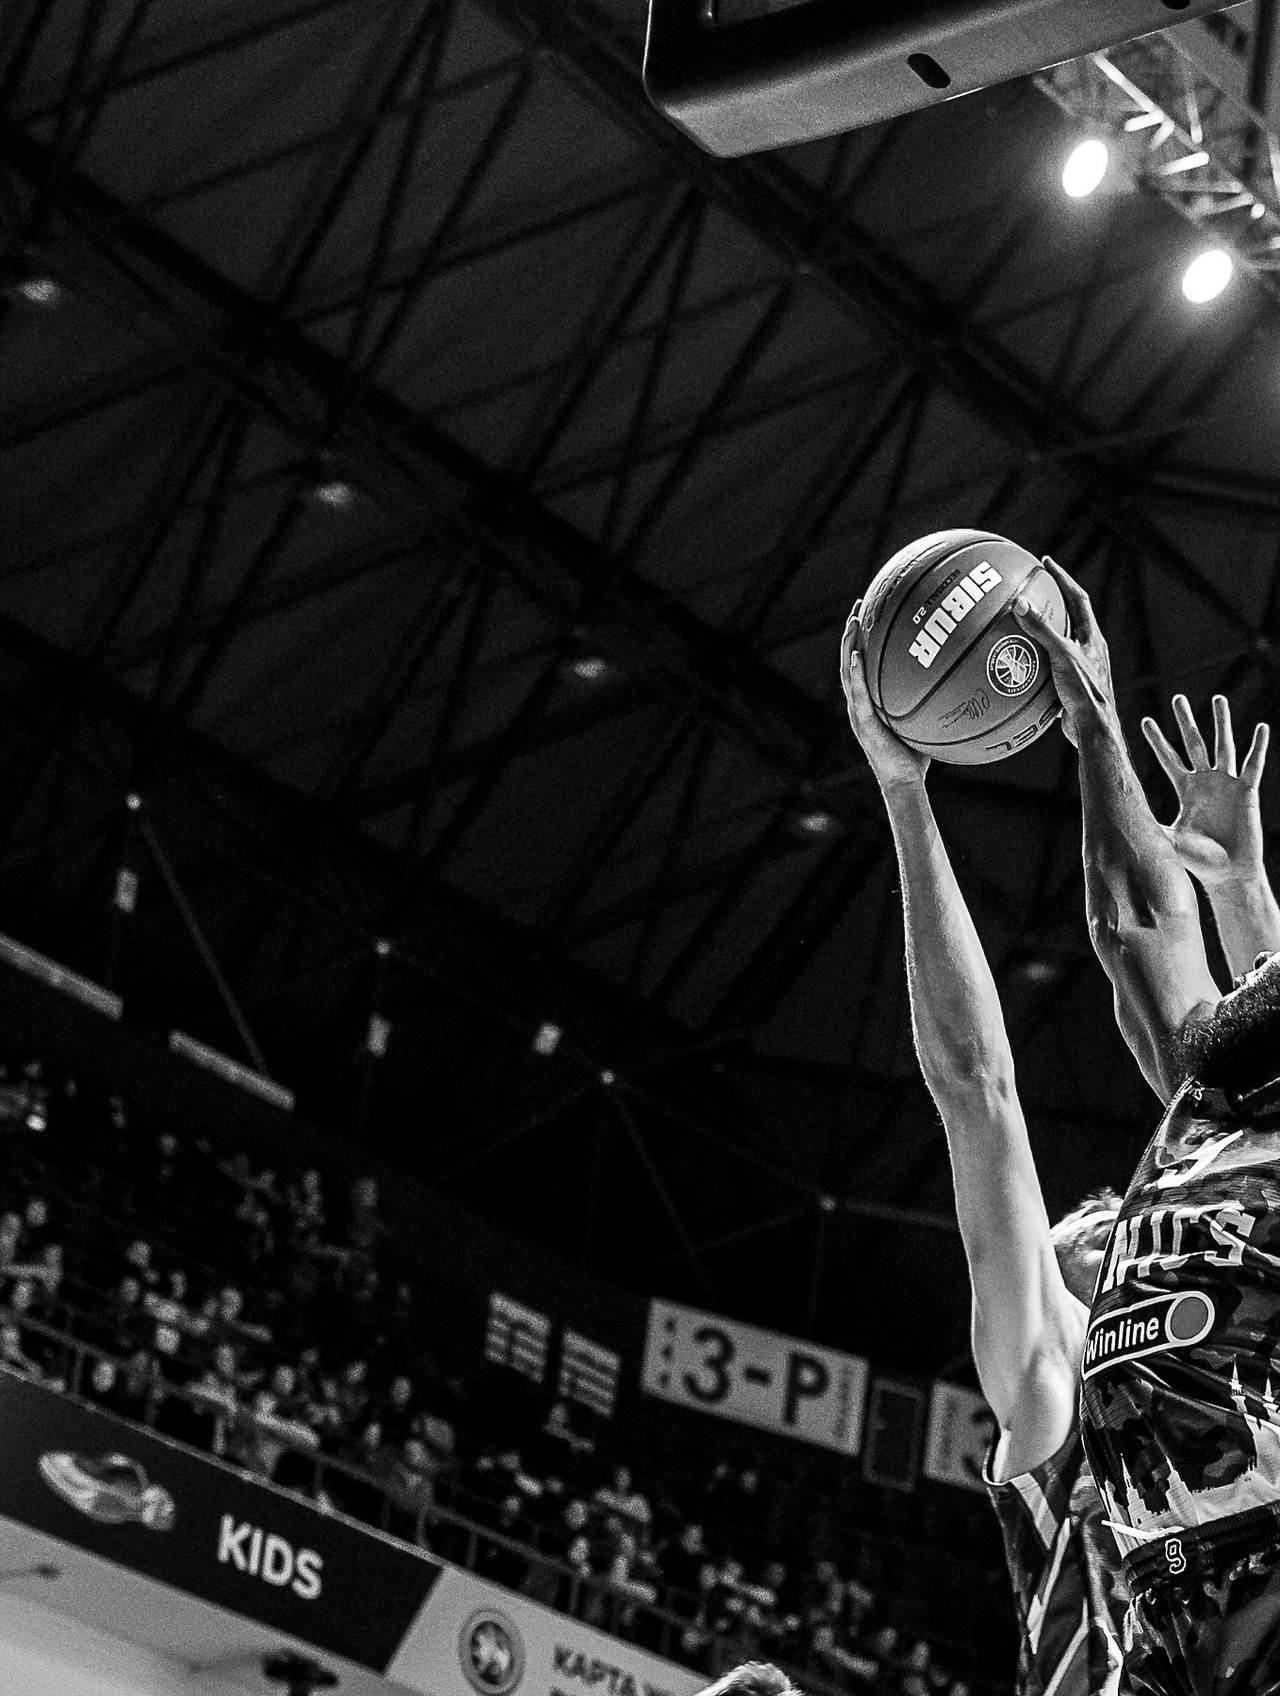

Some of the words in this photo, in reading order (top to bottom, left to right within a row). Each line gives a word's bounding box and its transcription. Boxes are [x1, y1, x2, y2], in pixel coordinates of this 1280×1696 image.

[908, 561, 1003, 669] SIBUR
[1102, 1206, 1256, 1293] NICS
[1085, 1317, 1160, 1365] Winline
[217, 1513, 325, 1600] KIDS
[1165, 1537, 1187, 1575] 9
